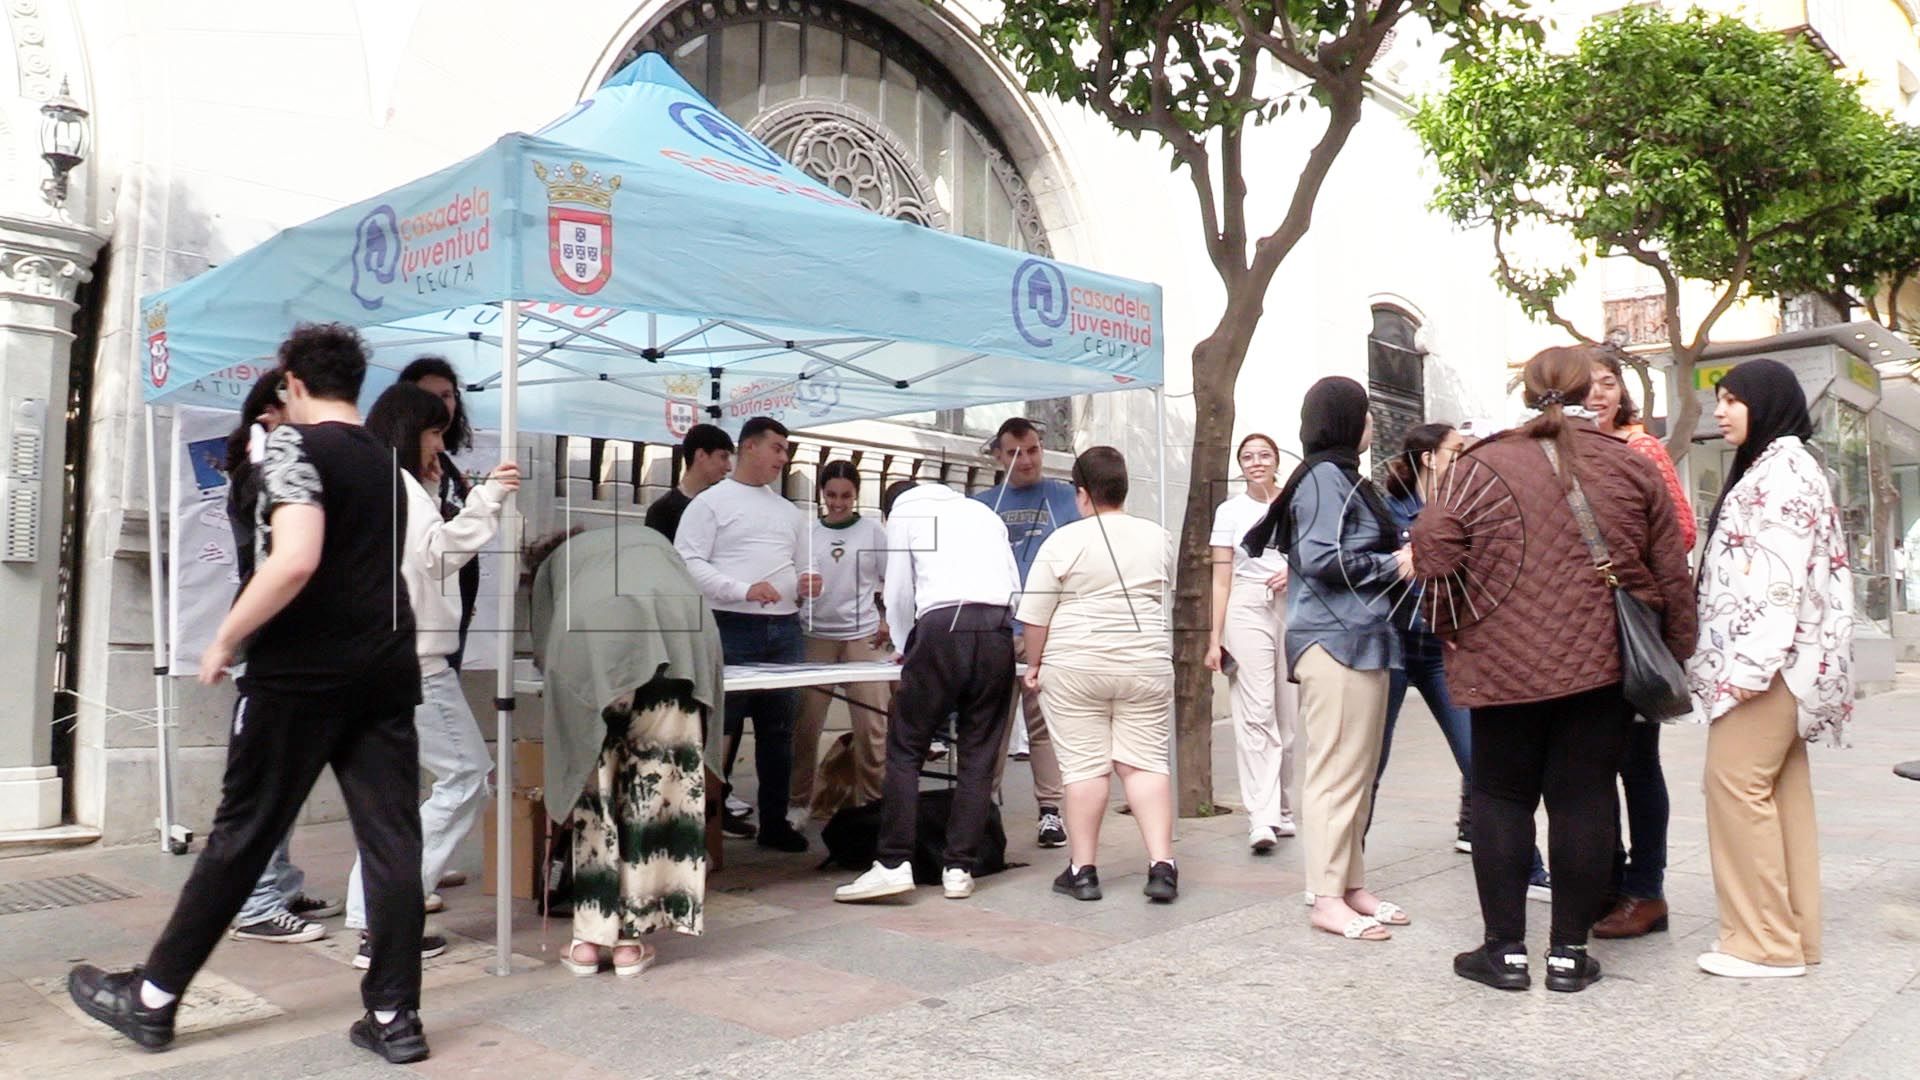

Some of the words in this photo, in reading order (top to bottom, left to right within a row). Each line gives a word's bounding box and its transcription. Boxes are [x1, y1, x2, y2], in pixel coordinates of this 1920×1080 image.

[402, 218, 489, 283] juventud
[416, 261, 474, 295] CEUTA
[1069, 306, 1152, 346] juventud
[1083, 336, 1138, 361] CEUTA
